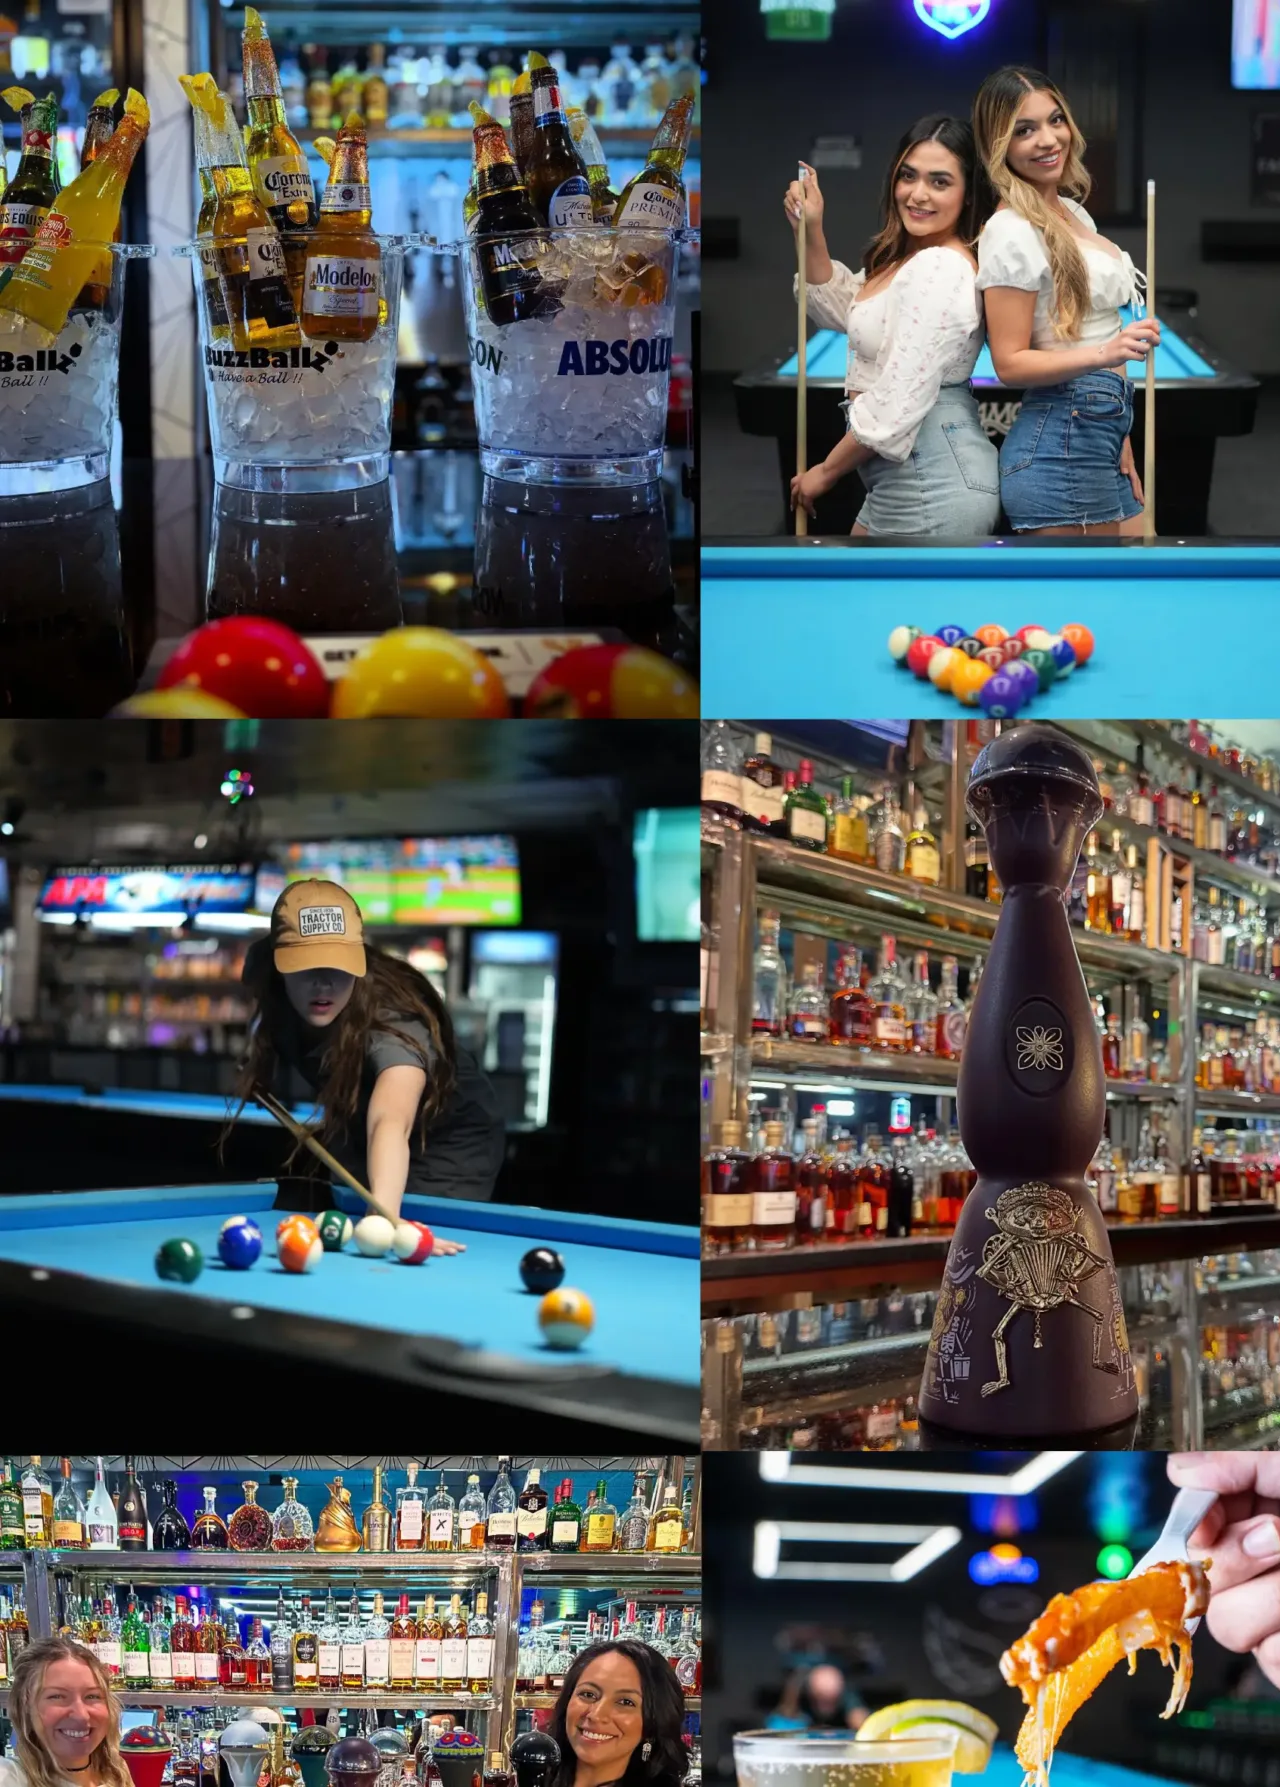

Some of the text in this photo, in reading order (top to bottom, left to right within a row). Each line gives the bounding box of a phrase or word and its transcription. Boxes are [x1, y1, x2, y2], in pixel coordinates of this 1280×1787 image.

[282, 187, 308, 198] Extra
[12, 213, 45, 227] EQUIS
[316, 263, 372, 287] Modelo
[557, 338, 672, 376] ABSOLU
[301, 913, 343, 924] TRACTOR
[302, 922, 344, 934] SUPPLY CO.
